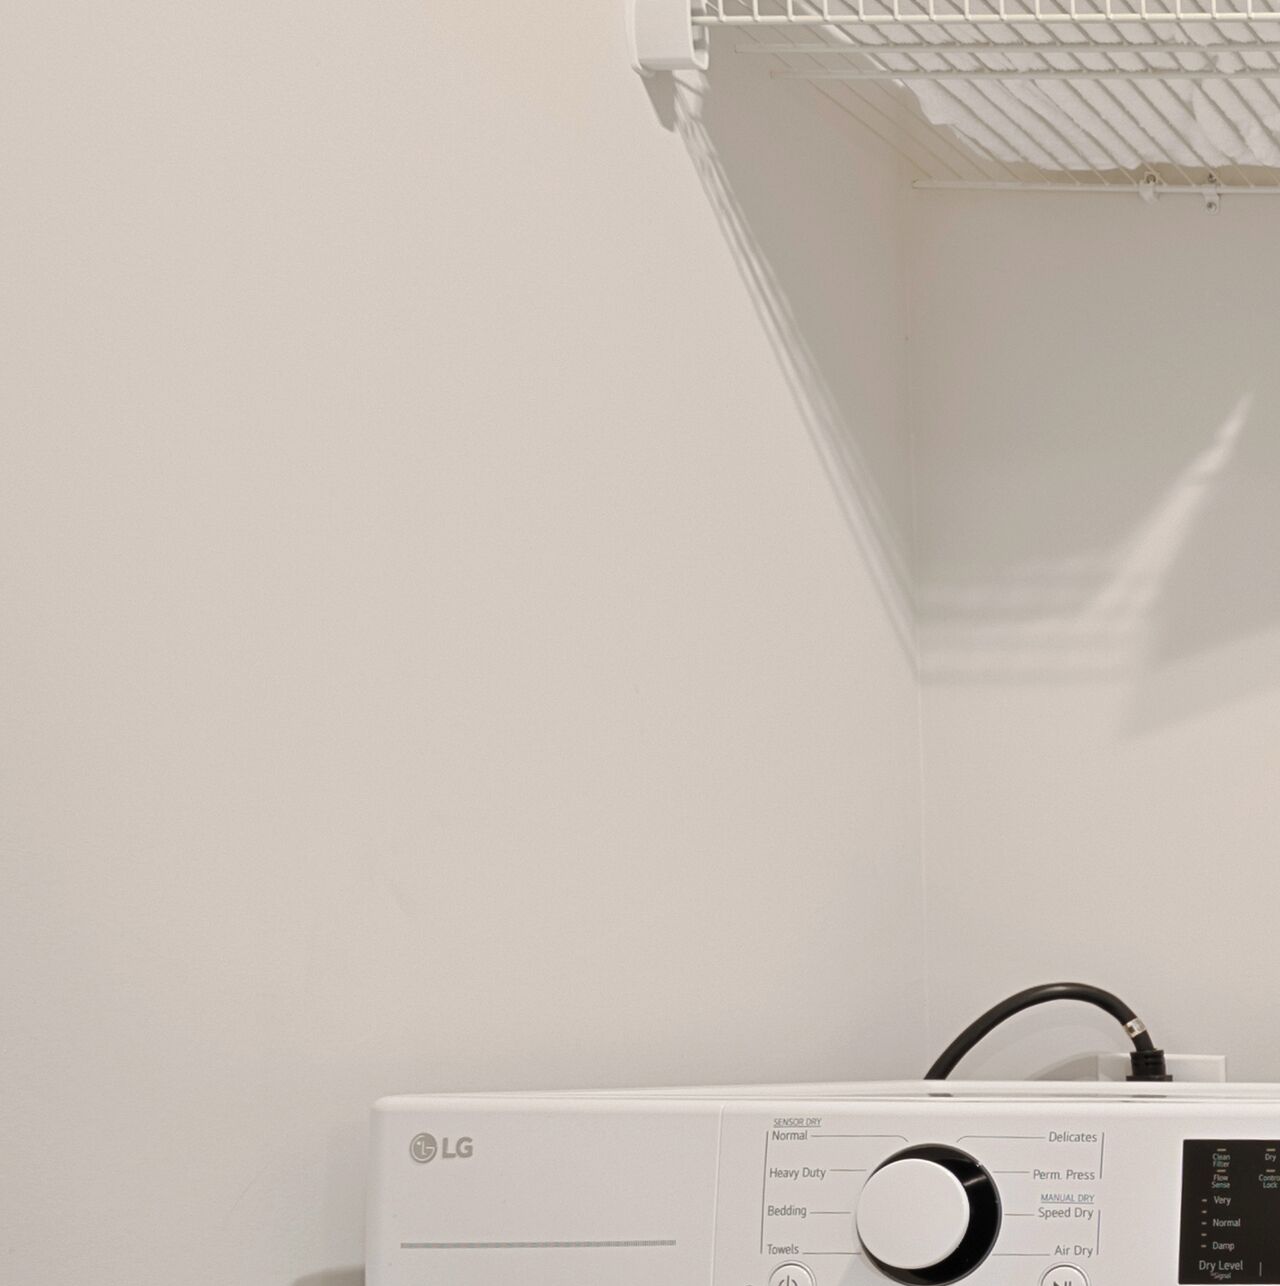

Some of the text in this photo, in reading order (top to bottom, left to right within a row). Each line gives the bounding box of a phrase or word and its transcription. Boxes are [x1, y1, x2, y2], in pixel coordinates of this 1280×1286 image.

[774, 1117, 822, 1126] SENSOR DRY
[772, 1130, 808, 1141] Normal
[1049, 1131, 1098, 1142] Delicates
[442, 1137, 473, 1159] LG
[1212, 1153, 1231, 1161] Clean
[1264, 1153, 1277, 1162] Dry
[769, 1167, 826, 1181] Heavy Duty
[1033, 1169, 1096, 1180] Perm. Press
[1263, 1181, 1278, 1189] Lock
[1041, 1194, 1095, 1202] MANUAL DRY
[1214, 1196, 1231, 1206] Very
[767, 1205, 807, 1219] Bedding
[1039, 1207, 1094, 1221] Speed Dry
[1212, 1218, 1241, 1227] Normal
[768, 1243, 800, 1255] Towels
[1054, 1245, 1094, 1258] Air Dry
[1212, 1241, 1235, 1252] Damp
[1199, 1260, 1243, 1272] Dry Level
